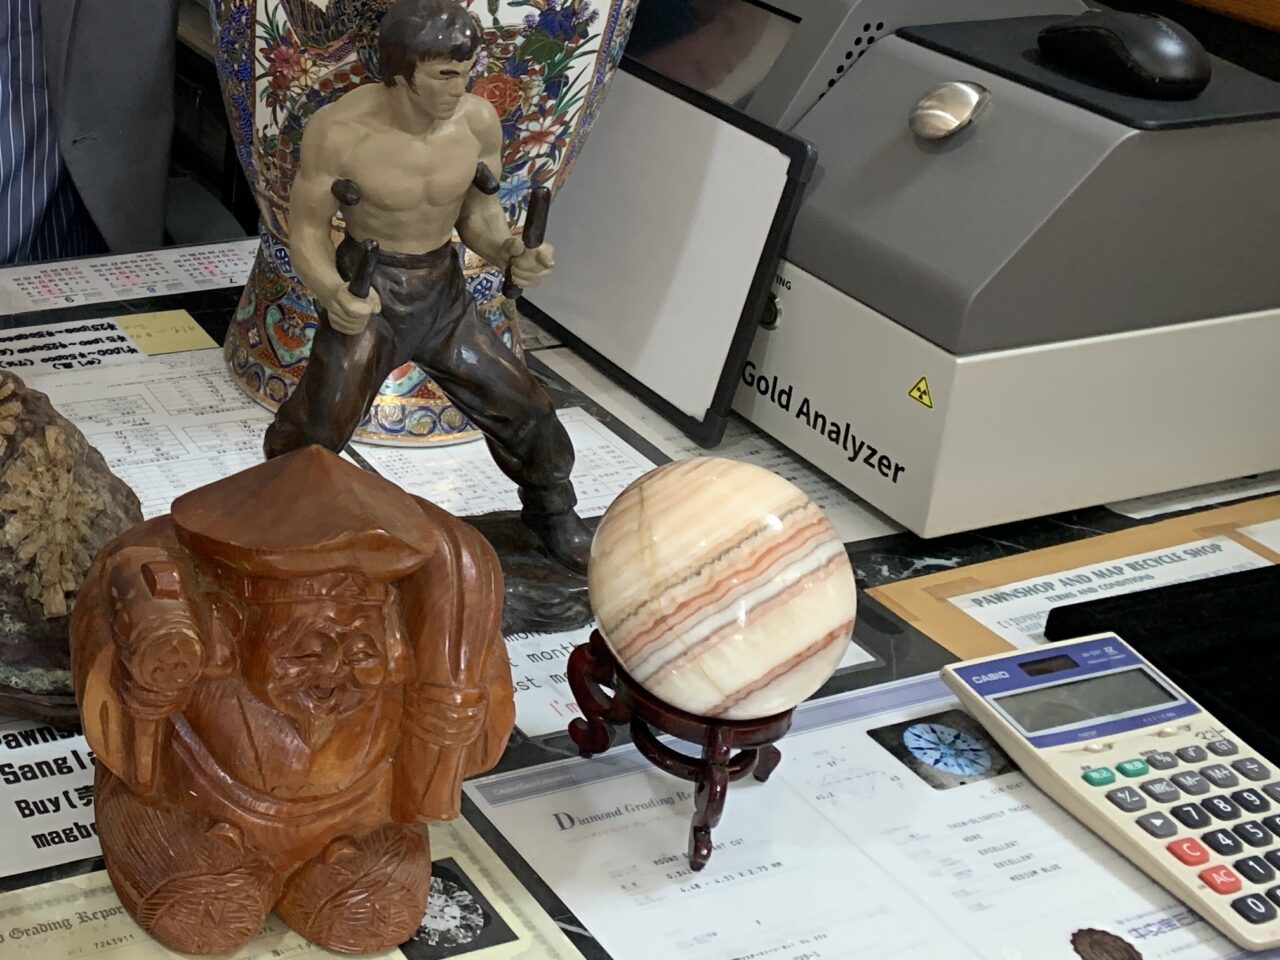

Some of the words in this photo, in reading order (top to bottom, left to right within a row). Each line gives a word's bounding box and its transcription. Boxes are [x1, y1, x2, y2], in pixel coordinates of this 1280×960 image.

[775, 275, 792, 290] ING
[741, 360, 794, 412] Gold
[795, 397, 906, 484] Analyzer
[971, 581, 1056, 608] PAWNSHOP
[1058, 568, 1093, 589] AND
[1093, 565, 1125, 582] MAP
[1128, 551, 1185, 574] RECYCLE
[1187, 542, 1224, 559] SHOP
[1045, 590, 1077, 603] TERMS
[1078, 585, 1099, 596] AND
[1099, 573, 1156, 592] CONDITIONS
[971, 670, 1010, 686] CASIO
[1149, 780, 1176, 794] MRC
[1183, 806, 1200, 820] 7
[1213, 798, 1232, 812] 8
[1243, 791, 1261, 805] 9
[553, 807, 623, 831] Diamond
[624, 797, 674, 815] Grading
[1220, 833, 1235, 846] 4
[1245, 824, 1264, 839] 5
[977, 840, 1019, 856] EXCELLENT
[1183, 843, 1201, 857] C
[993, 853, 1036, 869] EXCELLENT
[1248, 860, 1265, 874] 1
[1212, 870, 1236, 884] AC
[1246, 897, 1266, 913] 0
[9, 916, 73, 939] Grading
[77, 904, 125, 925] Repor
